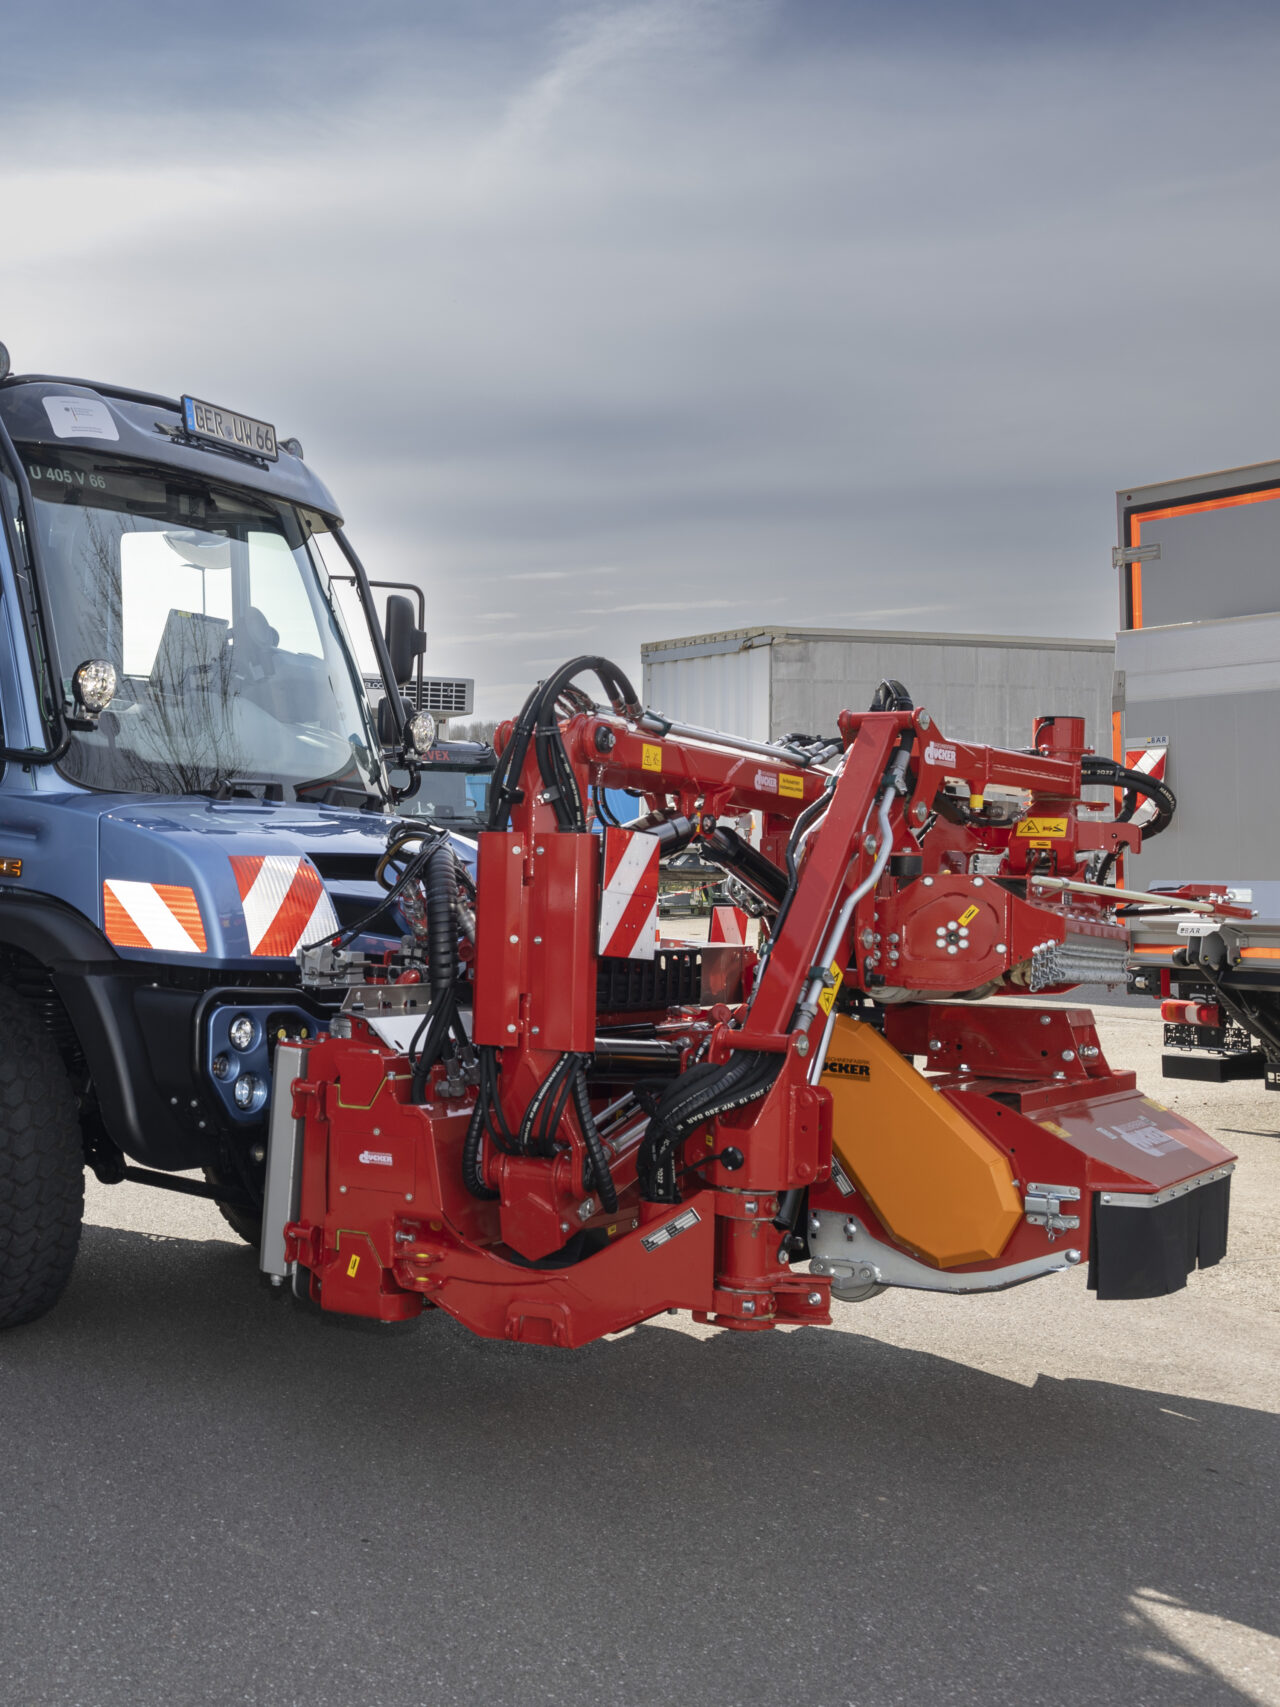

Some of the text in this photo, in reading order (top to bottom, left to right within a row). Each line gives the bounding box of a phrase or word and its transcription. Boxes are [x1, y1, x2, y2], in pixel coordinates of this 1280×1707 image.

[194, 404, 273, 452] GER UW 66
[29, 466, 106, 489] U 405 V 66
[1151, 736, 1167, 744] BAR
